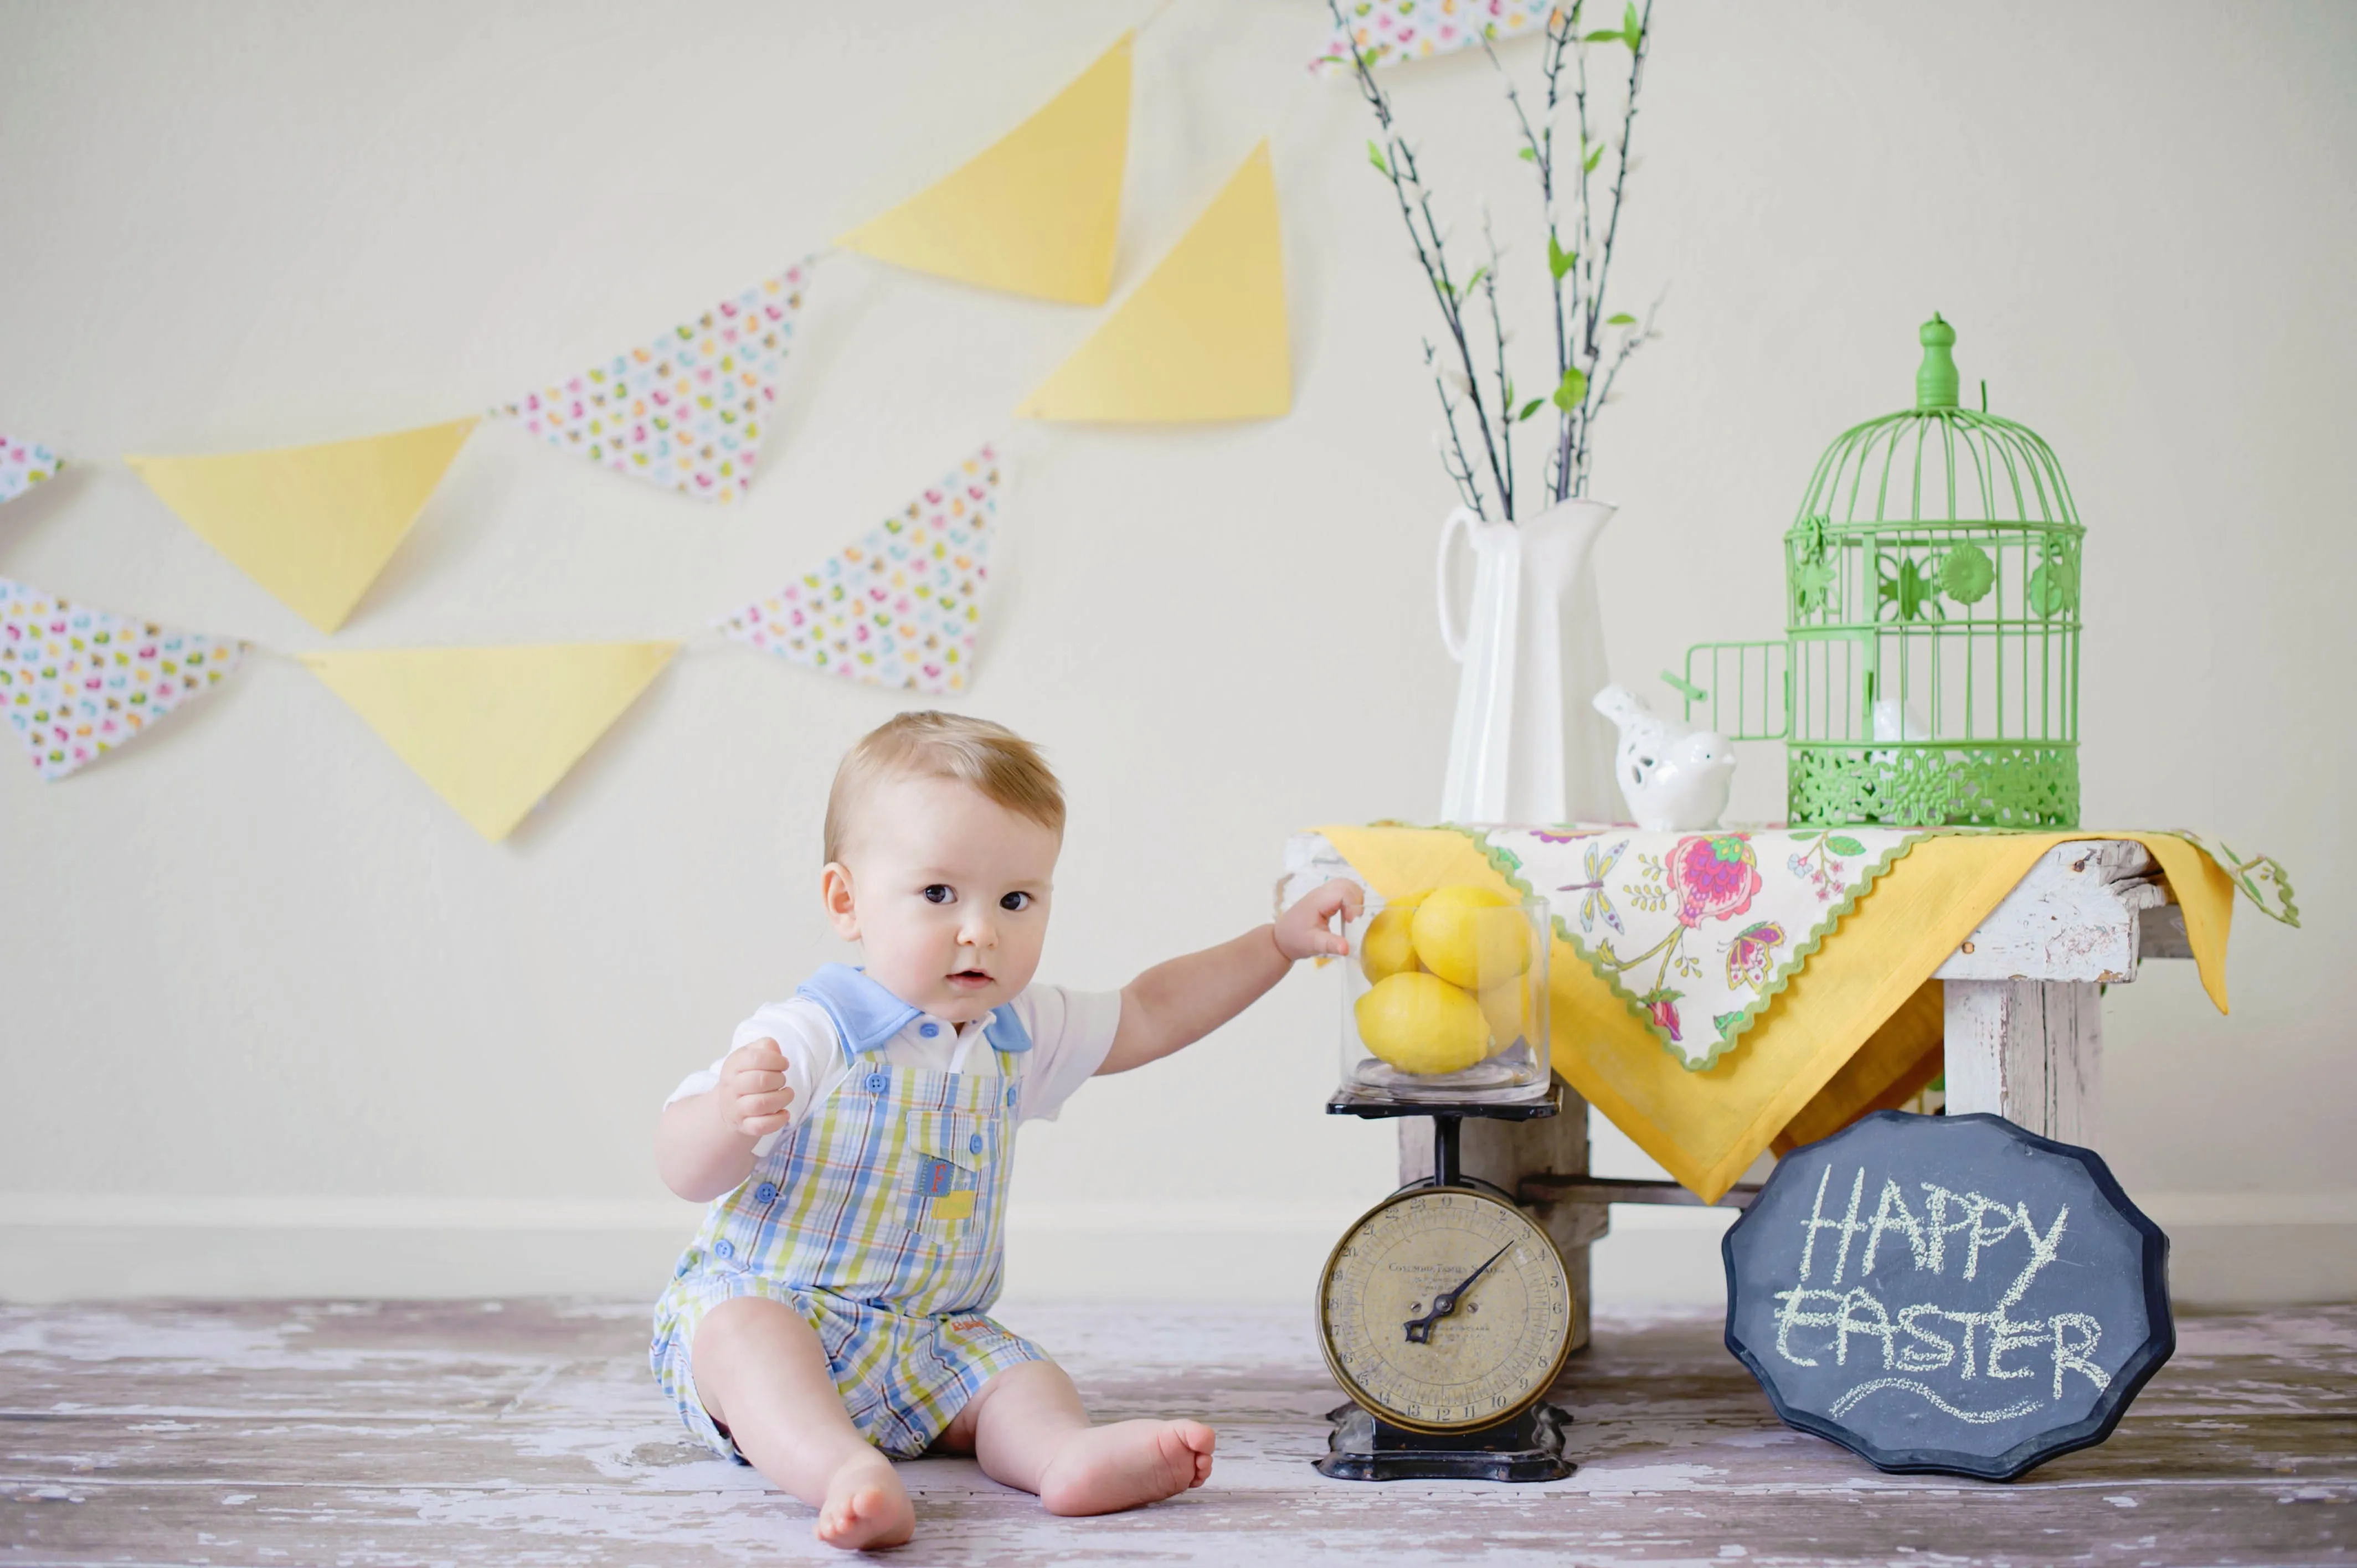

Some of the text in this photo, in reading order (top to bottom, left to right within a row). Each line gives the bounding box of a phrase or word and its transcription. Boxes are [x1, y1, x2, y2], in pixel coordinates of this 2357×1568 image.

[932, 1164, 946, 1193] F
[1410, 1198, 1426, 1209] 23
[1442, 1195, 1452, 1208] 0
[1474, 1199, 1479, 1210] 1
[1385, 1208, 1399, 1219] 22
[1500, 1209, 1507, 1221] 2
[1363, 1224, 1375, 1235] 21
[1522, 1227, 1531, 1239] 3
[1799, 1163, 2070, 1312] HAPPY
[1342, 1247, 1357, 1257] 20
[1539, 1249, 1550, 1261] 4
[1550, 1276, 1559, 1288] 5
[1553, 1302, 1562, 1314] 6
[1549, 1329, 1558, 1342] 7
[1773, 1284, 2113, 1401] EASTER
[1538, 1355, 1548, 1368] 8
[1520, 1378, 1529, 1390] 9
[1379, 1391, 1391, 1404] 14
[1491, 1396, 1506, 1408] 10
[1407, 1404, 1420, 1417] 13
[1436, 1408, 1451, 1421] 12
[1464, 1406, 1475, 1418] 11
